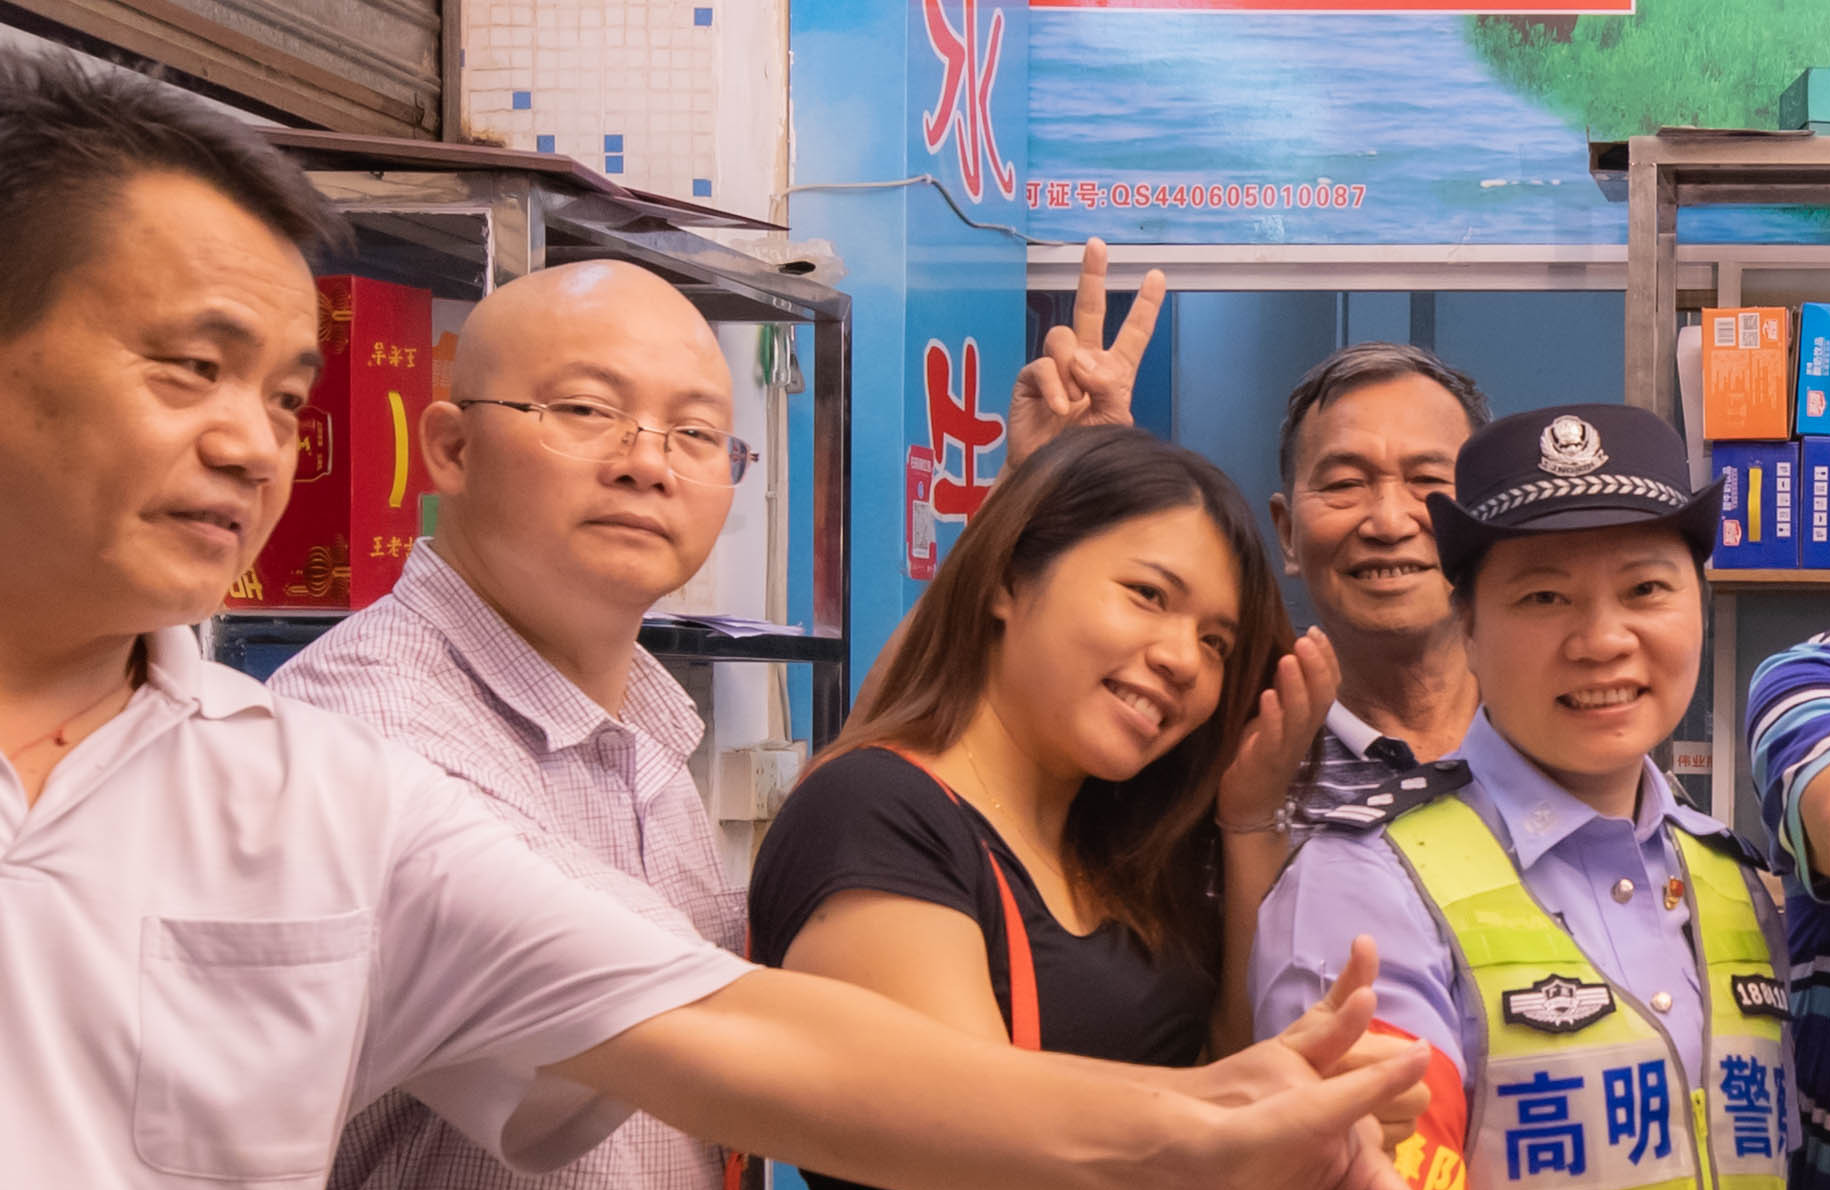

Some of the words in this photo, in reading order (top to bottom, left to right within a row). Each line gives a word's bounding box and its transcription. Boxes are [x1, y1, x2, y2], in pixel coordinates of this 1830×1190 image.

[371, 342, 417, 368] 王老吉
[1496, 1058, 1672, 1181] 高明
